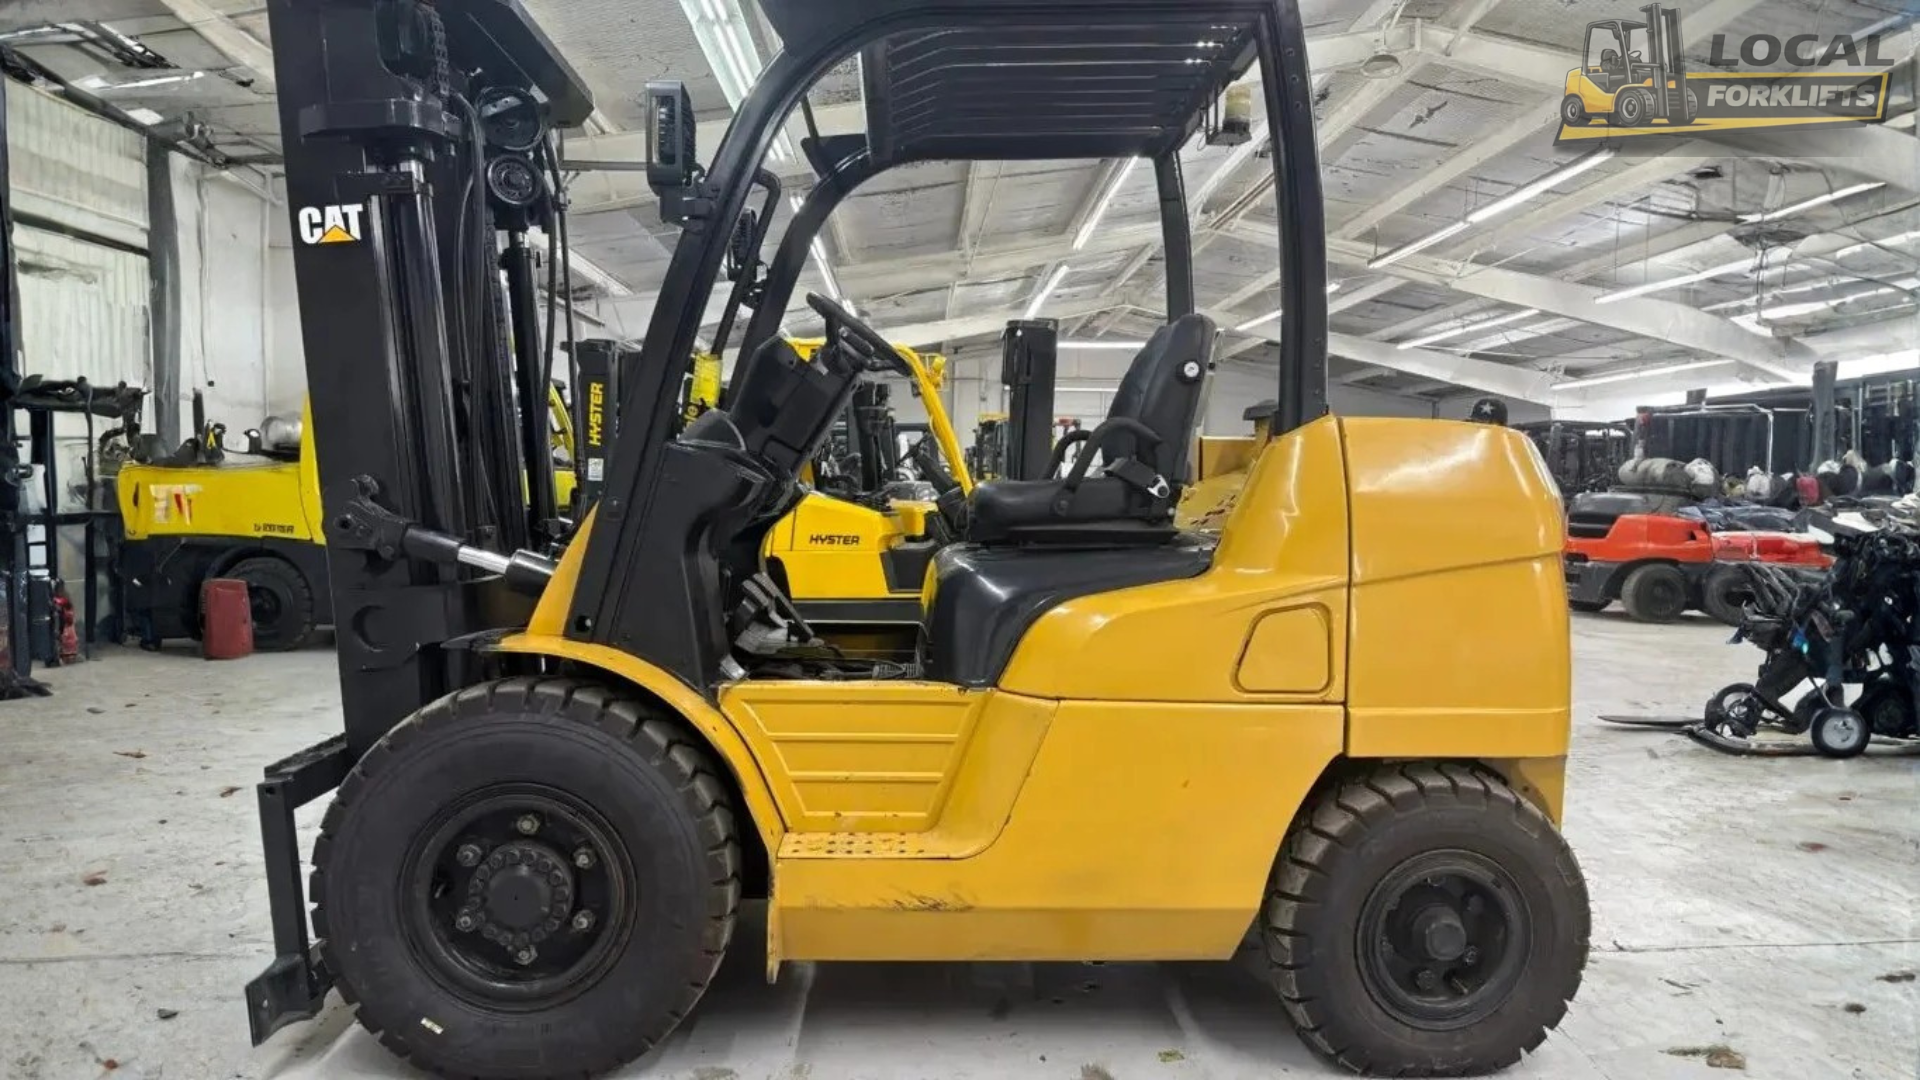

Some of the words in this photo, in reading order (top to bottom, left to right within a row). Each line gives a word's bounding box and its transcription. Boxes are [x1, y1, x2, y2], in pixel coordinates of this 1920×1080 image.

[298, 204, 363, 244] CAT
[588, 382, 604, 446] HYSTER
[809, 534, 860, 545] HYSTER
